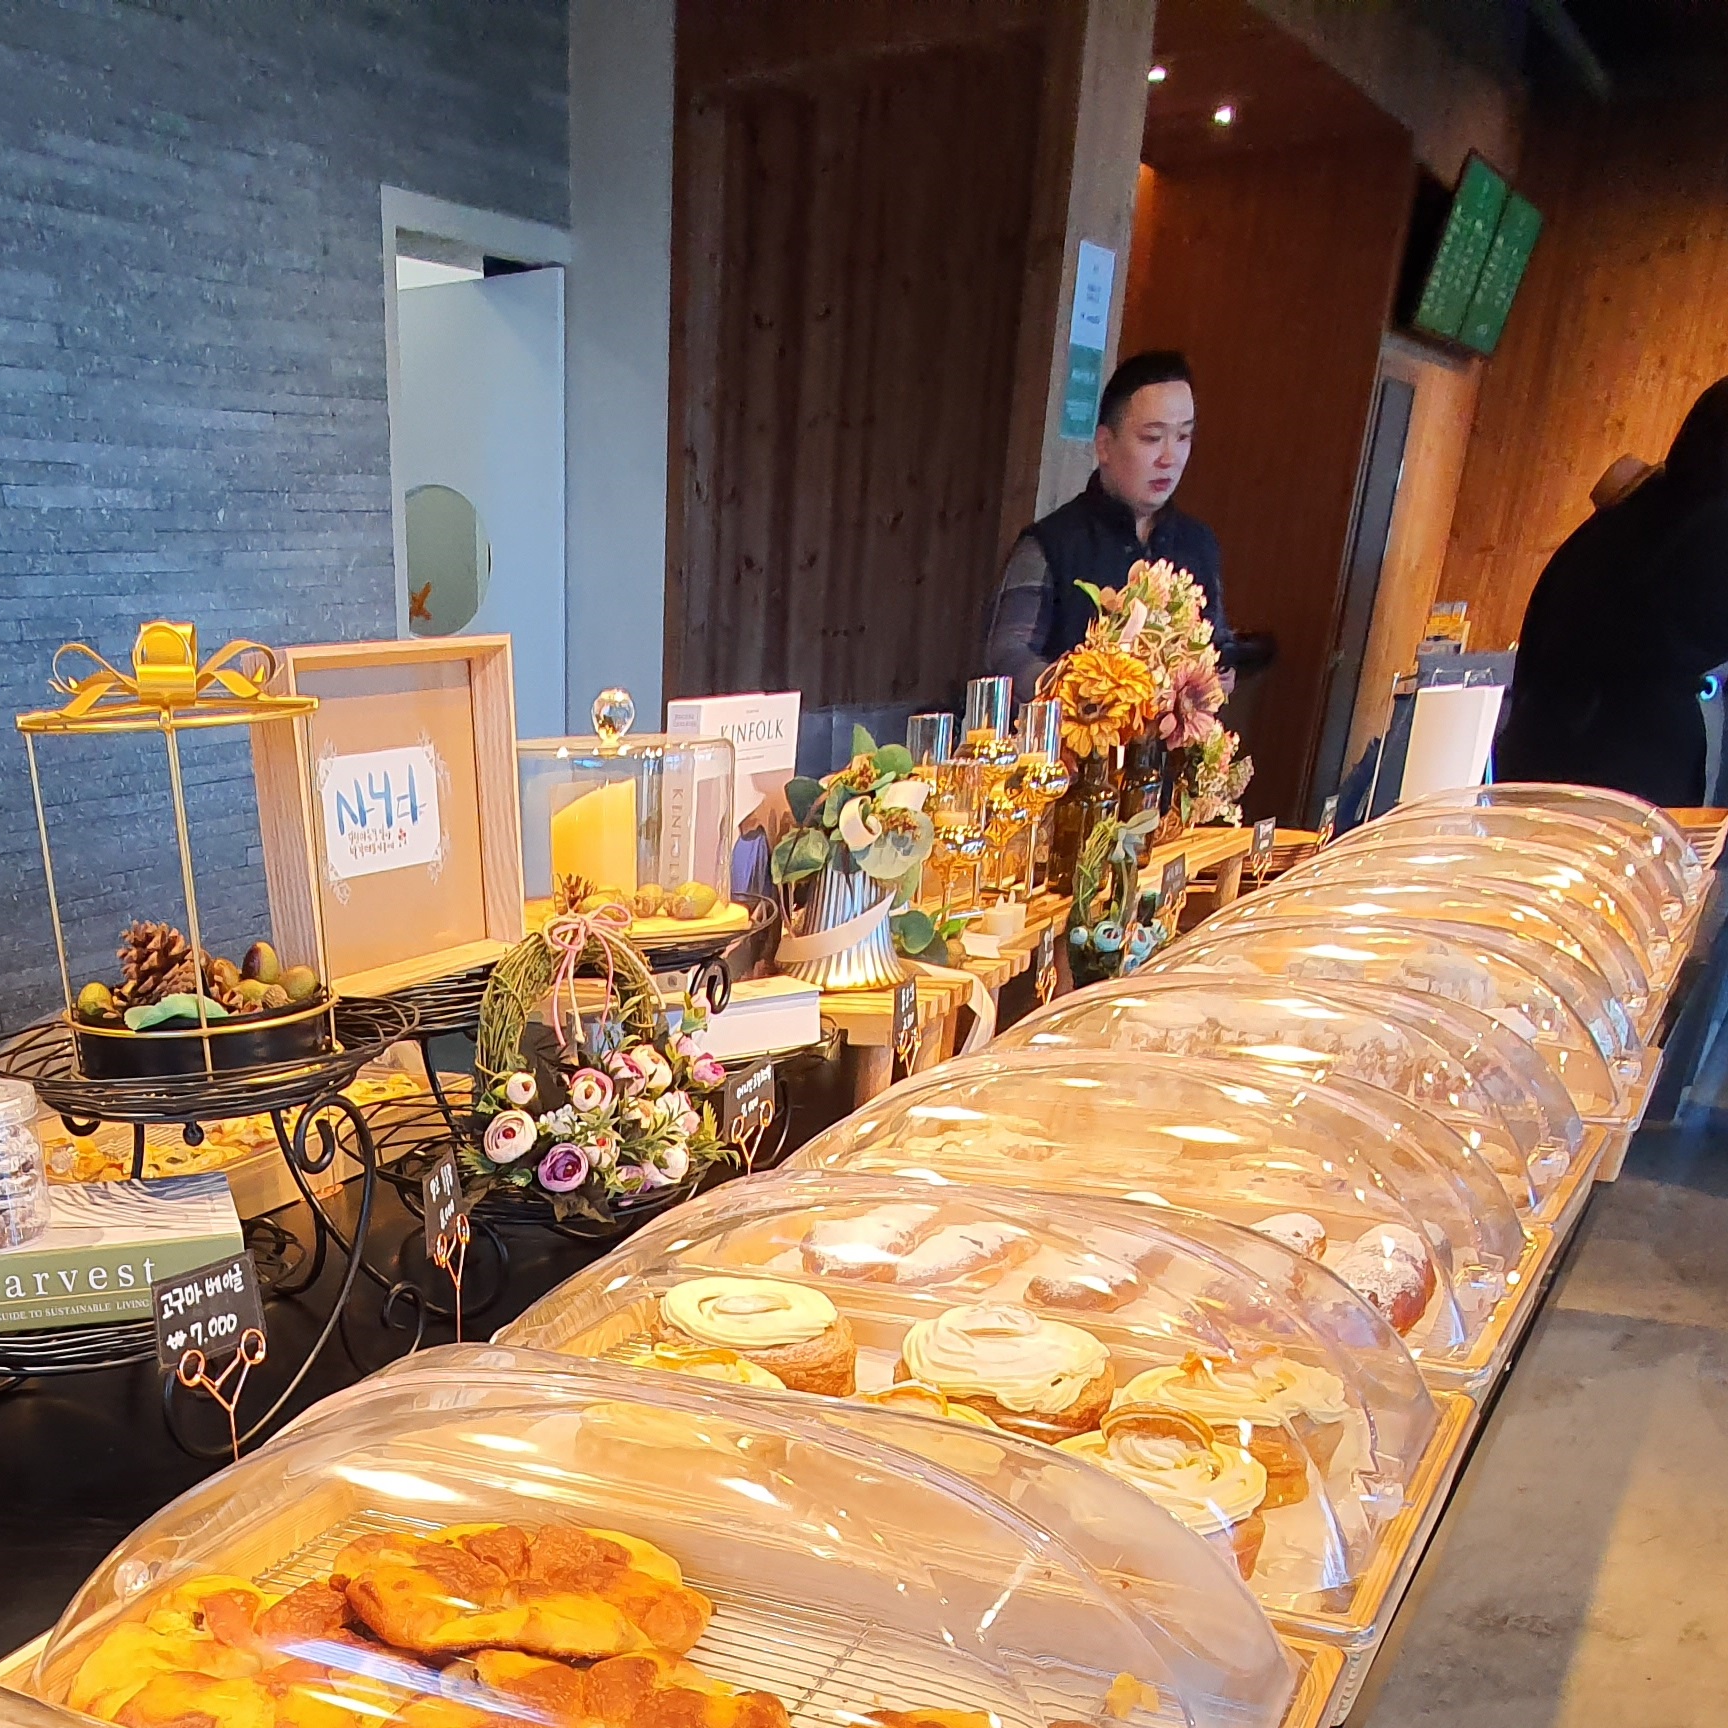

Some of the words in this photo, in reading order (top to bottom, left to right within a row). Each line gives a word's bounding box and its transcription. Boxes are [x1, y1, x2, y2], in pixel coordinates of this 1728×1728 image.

[720, 718, 785, 745] KINFOLK
[29, 1308, 43, 1319] TO
[44, 1302, 111, 1317] SUSTAINABLE
[116, 1298, 151, 1311] LIVING
[160, 1283, 203, 1319] 고구마
